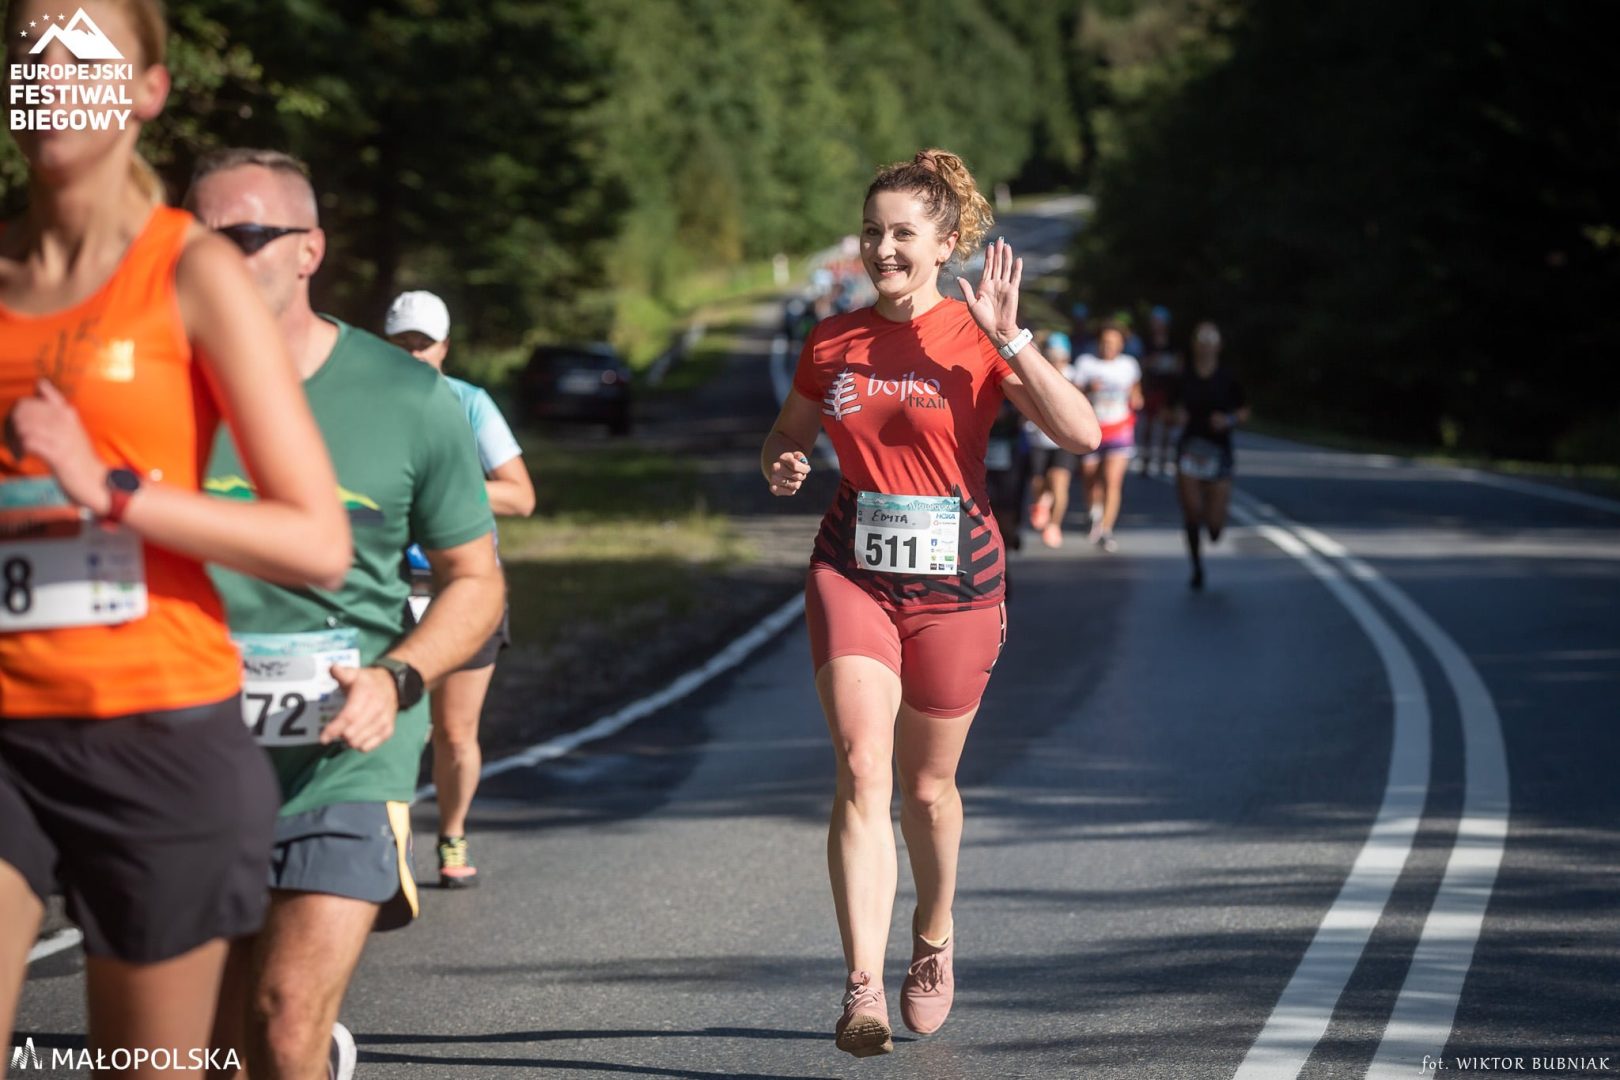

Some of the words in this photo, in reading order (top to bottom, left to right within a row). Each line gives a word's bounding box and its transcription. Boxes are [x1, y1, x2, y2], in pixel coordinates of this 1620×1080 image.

[867, 371, 941, 402] bojko
[865, 532, 917, 569] 511
[246, 693, 307, 736] 72
